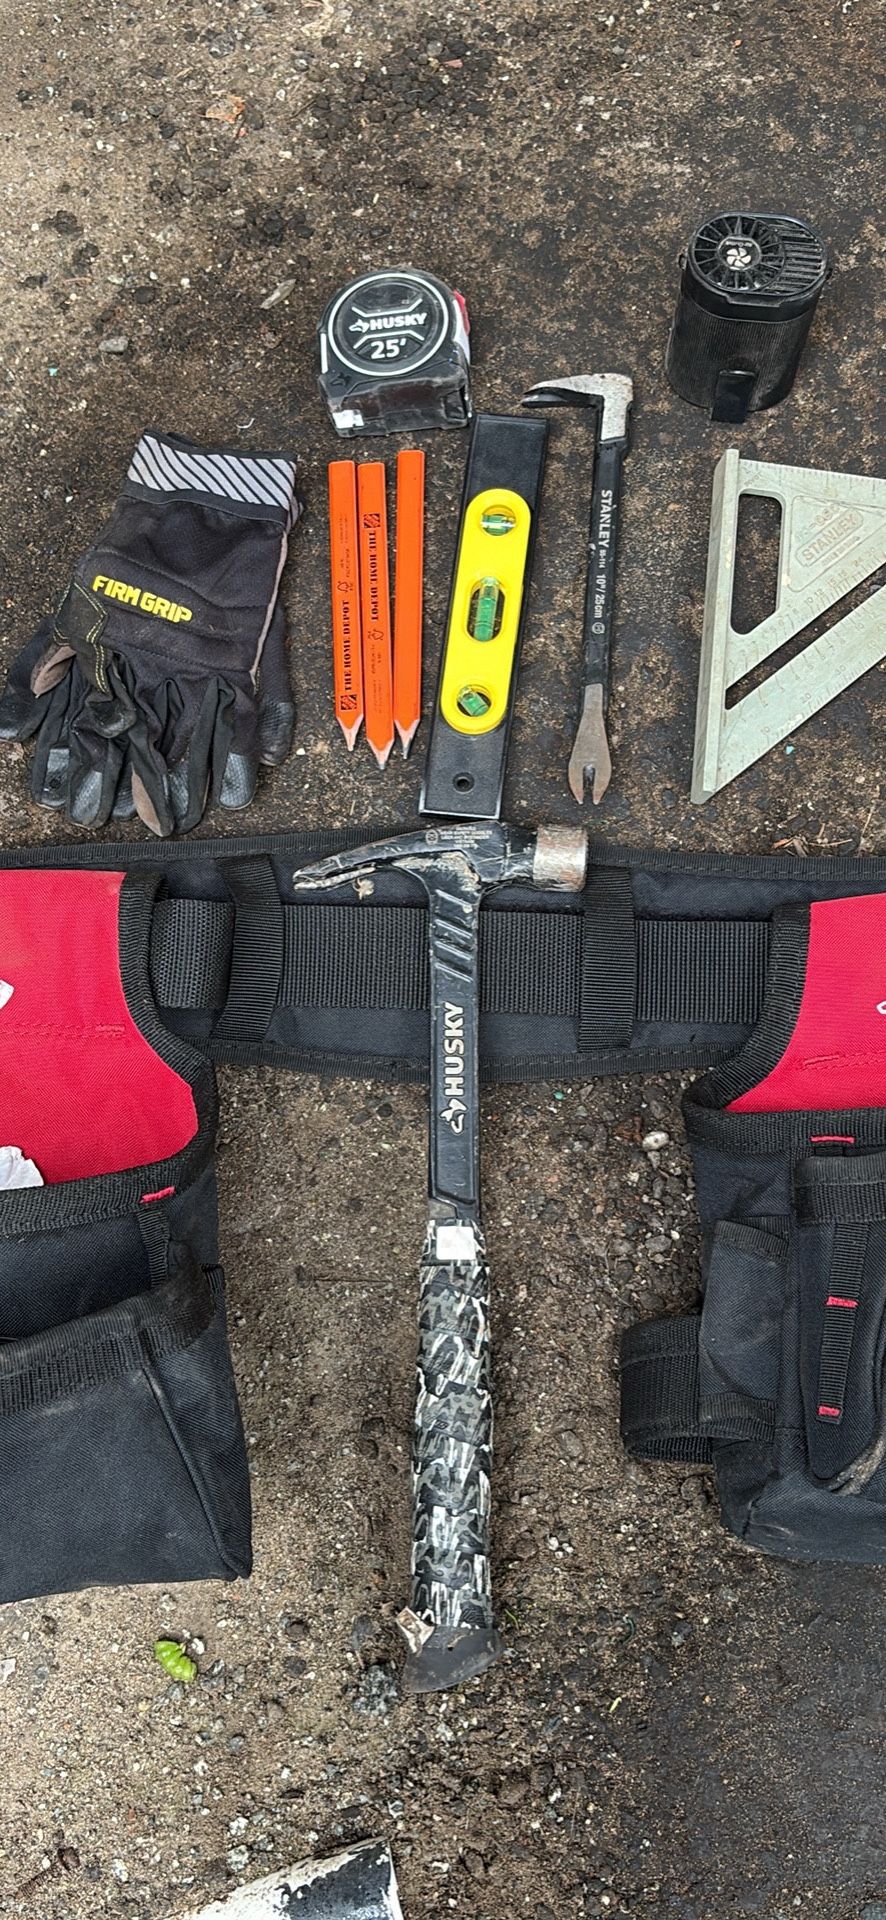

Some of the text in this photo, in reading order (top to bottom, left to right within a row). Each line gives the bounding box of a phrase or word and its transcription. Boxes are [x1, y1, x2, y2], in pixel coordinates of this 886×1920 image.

[368, 312, 428, 331] HUSKY
[370, 338, 407, 360] 25'
[598, 489, 613, 548] STANLEY
[368, 531, 377, 552] THE
[801, 512, 859, 561] STANLEY
[369, 554, 378, 585] HOME
[92, 575, 193, 623] FIRM GRIP
[370, 587, 379, 621] DEPOT
[342, 600, 351, 635] DEPOT
[343, 637, 352, 668] HOME
[344, 670, 352, 691] THE
[444, 1001, 464, 1096] HUSKY
